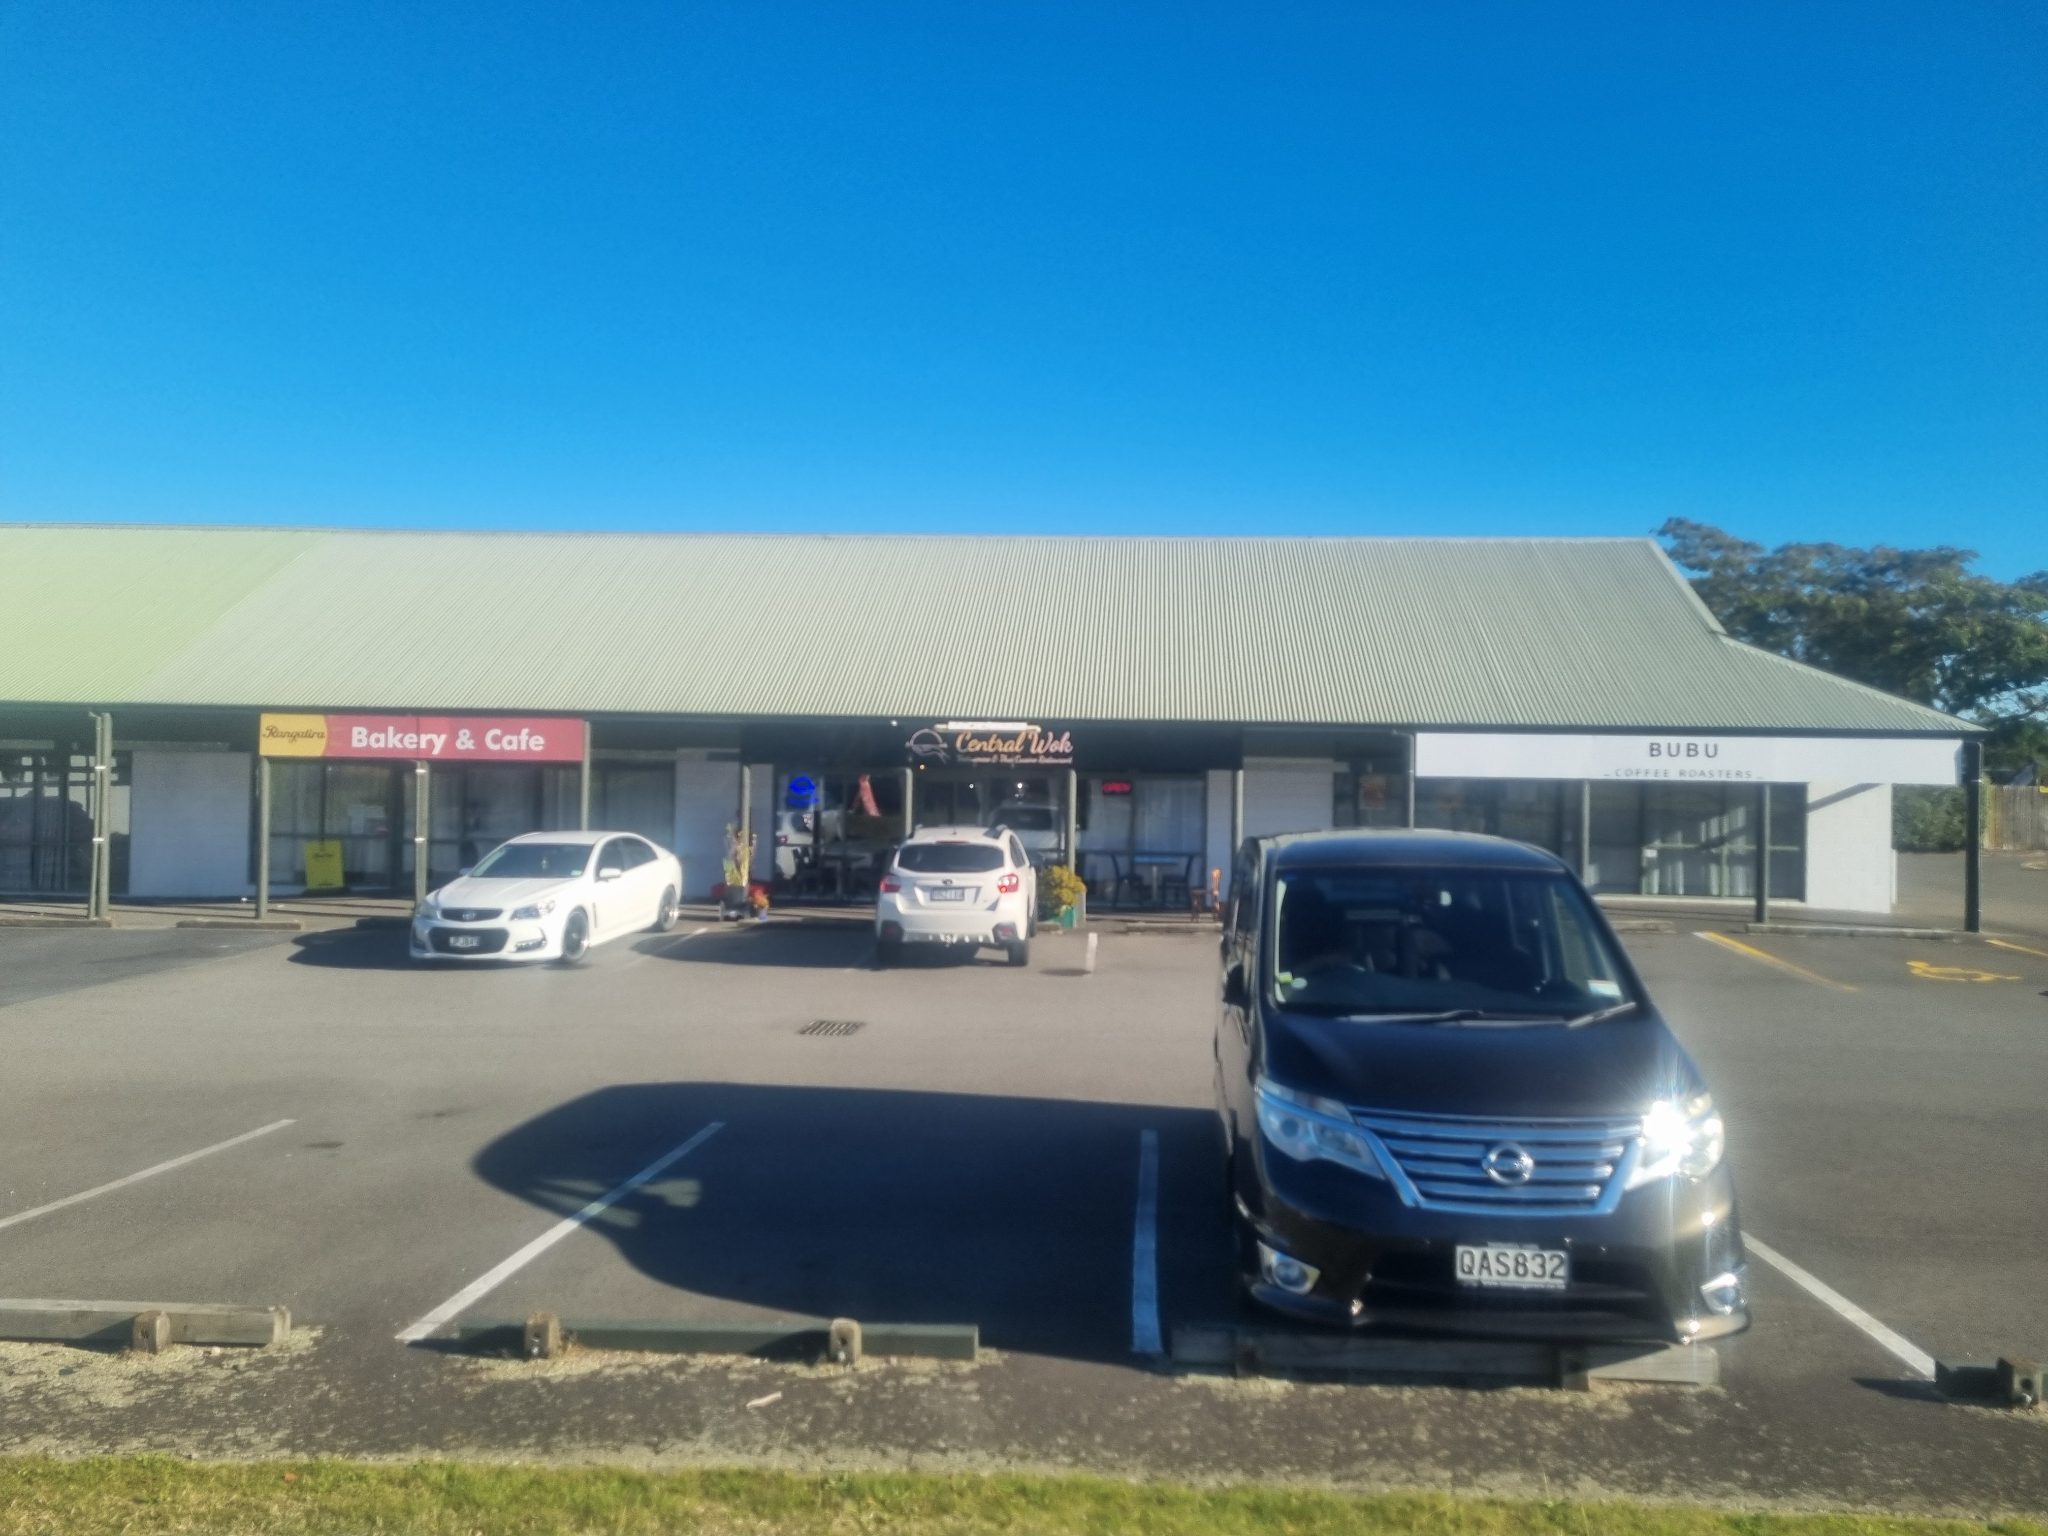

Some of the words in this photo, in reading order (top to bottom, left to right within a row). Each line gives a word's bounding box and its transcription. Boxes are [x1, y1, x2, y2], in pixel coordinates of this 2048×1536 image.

[351, 726, 448, 755] Bakery
[456, 728, 476, 750] &
[484, 727, 546, 751] Cafe
[955, 731, 1026, 753] Central
[1027, 731, 1073, 754] Wok
[1649, 742, 1719, 759] BUBU
[1614, 768, 1670, 778] COFFEE
[1678, 769, 1753, 779] ROASTERS
[1460, 1250, 1566, 1279] QAS832
